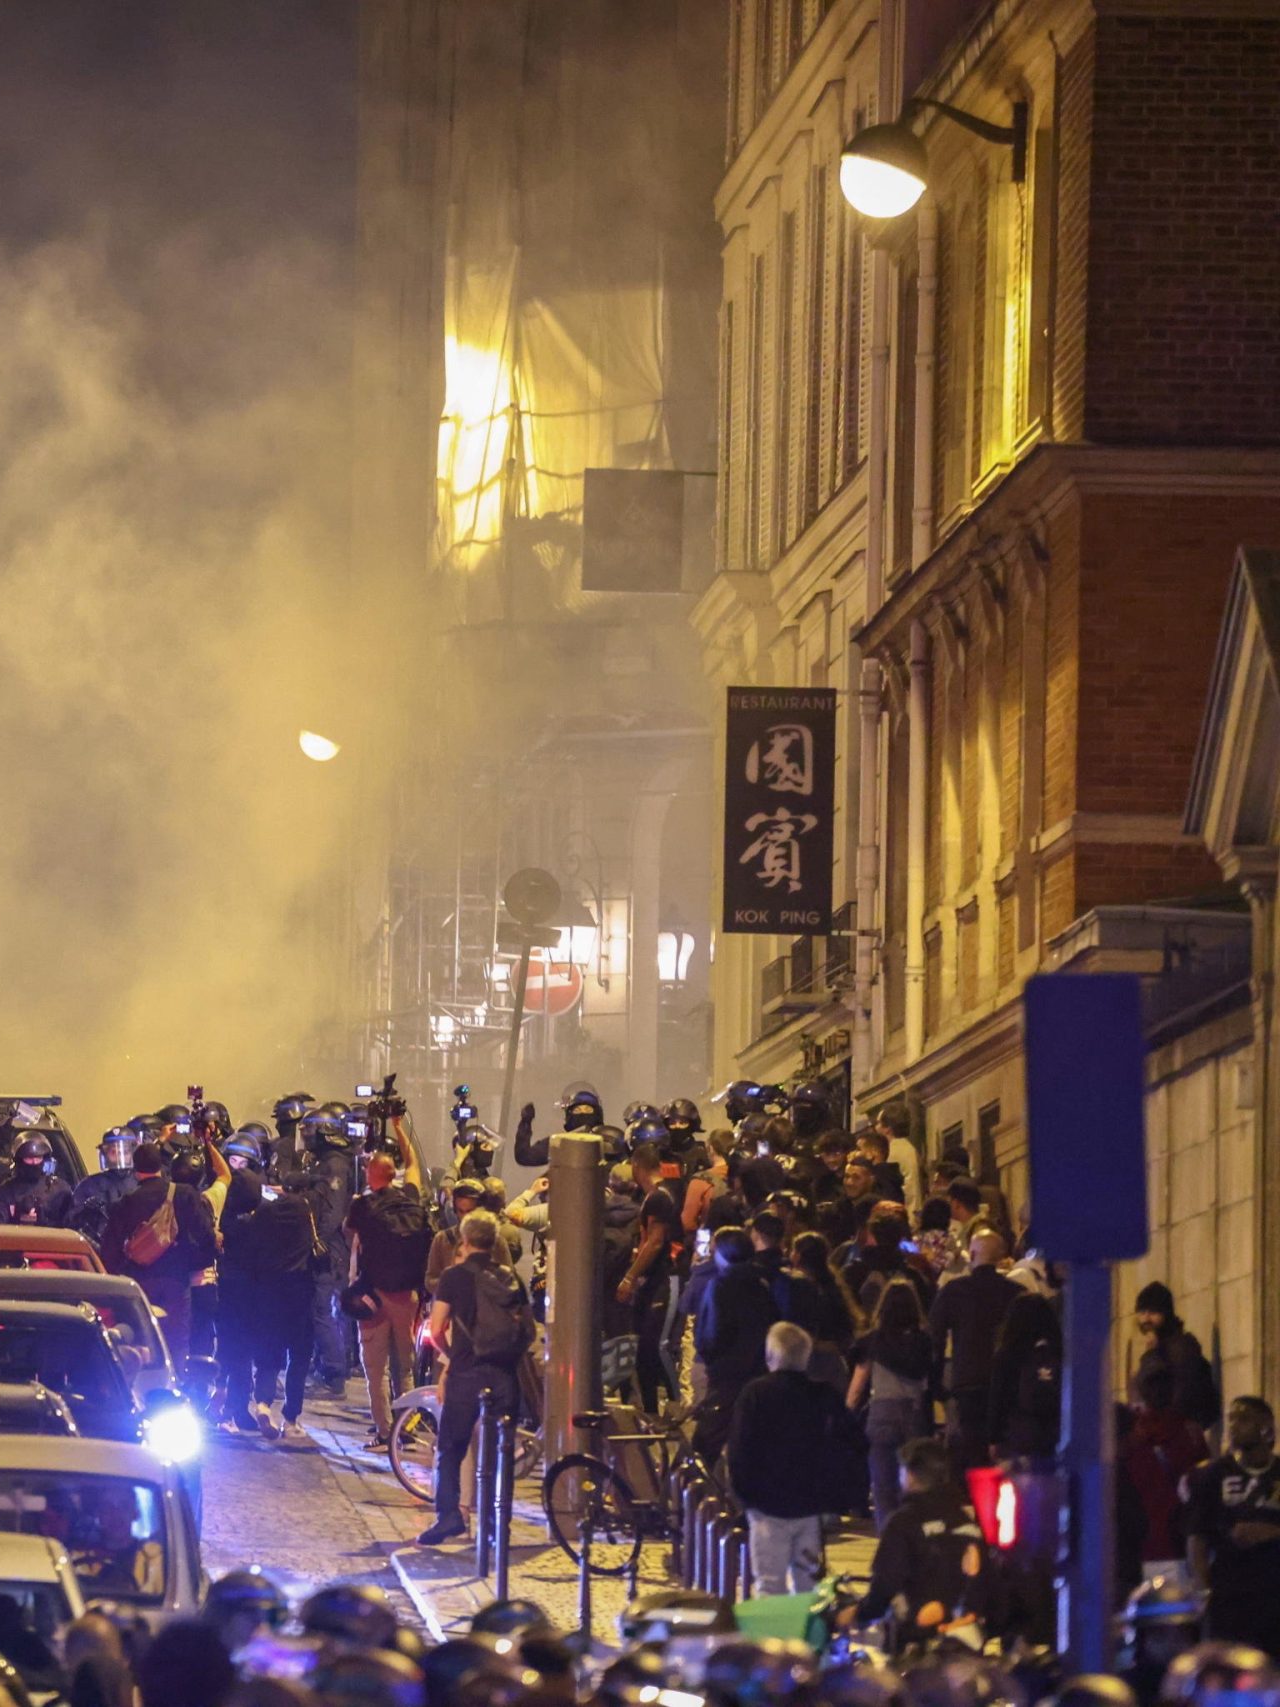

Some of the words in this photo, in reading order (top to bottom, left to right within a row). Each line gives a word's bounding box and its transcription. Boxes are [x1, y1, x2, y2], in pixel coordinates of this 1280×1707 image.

[730, 693, 834, 711] RESTAURANT
[734, 910, 769, 925] KOK
[779, 910, 821, 926] PING
